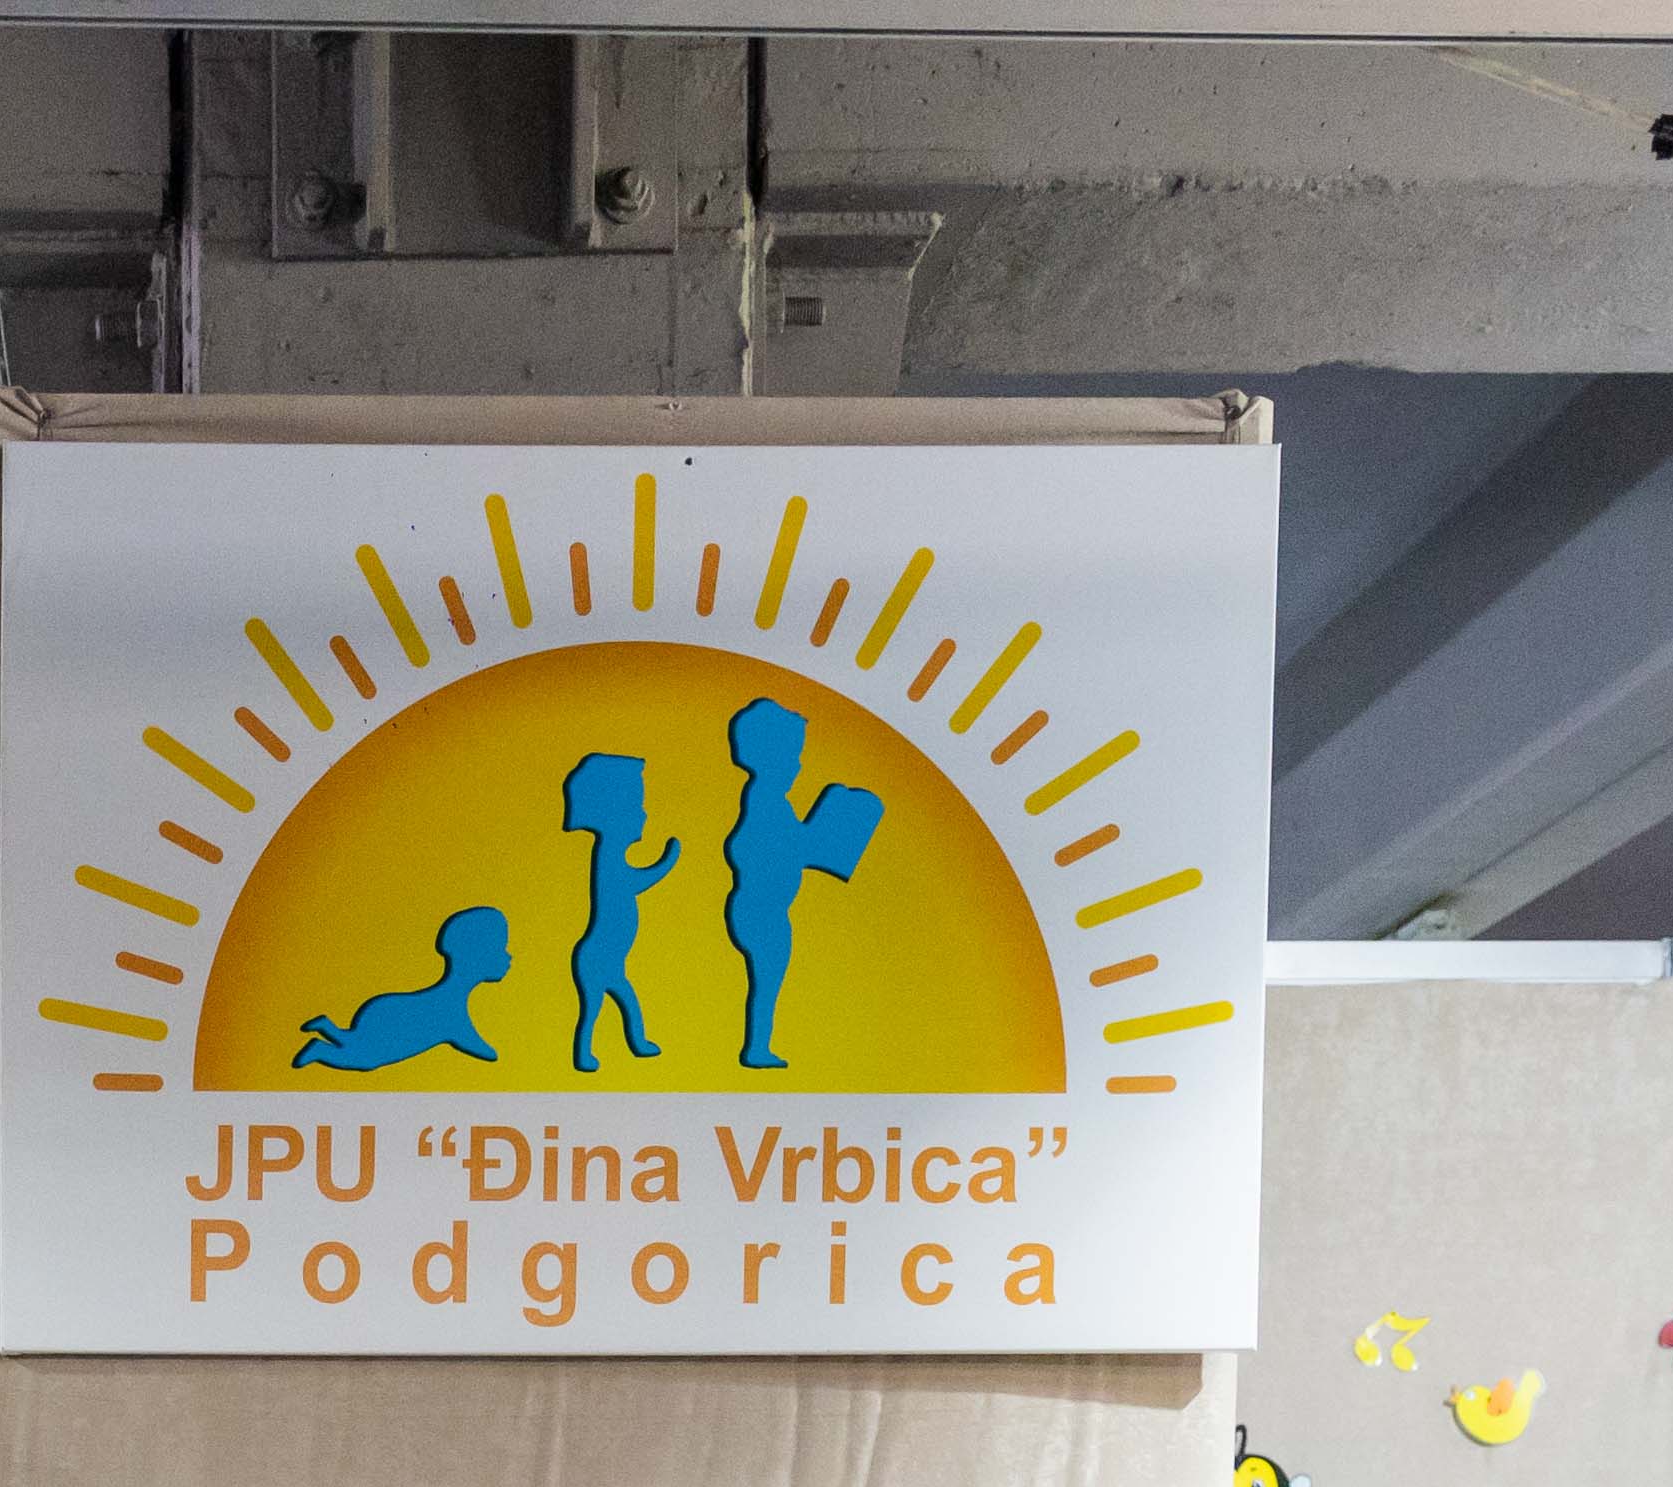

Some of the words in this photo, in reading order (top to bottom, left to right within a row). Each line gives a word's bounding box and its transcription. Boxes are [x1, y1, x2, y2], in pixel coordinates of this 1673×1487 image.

[185, 1123, 377, 1205] JPU
[416, 1124, 681, 1204] “Đina
[713, 1124, 1069, 1204] Vrbica”
[189, 1218, 1059, 1328] Podgorica
